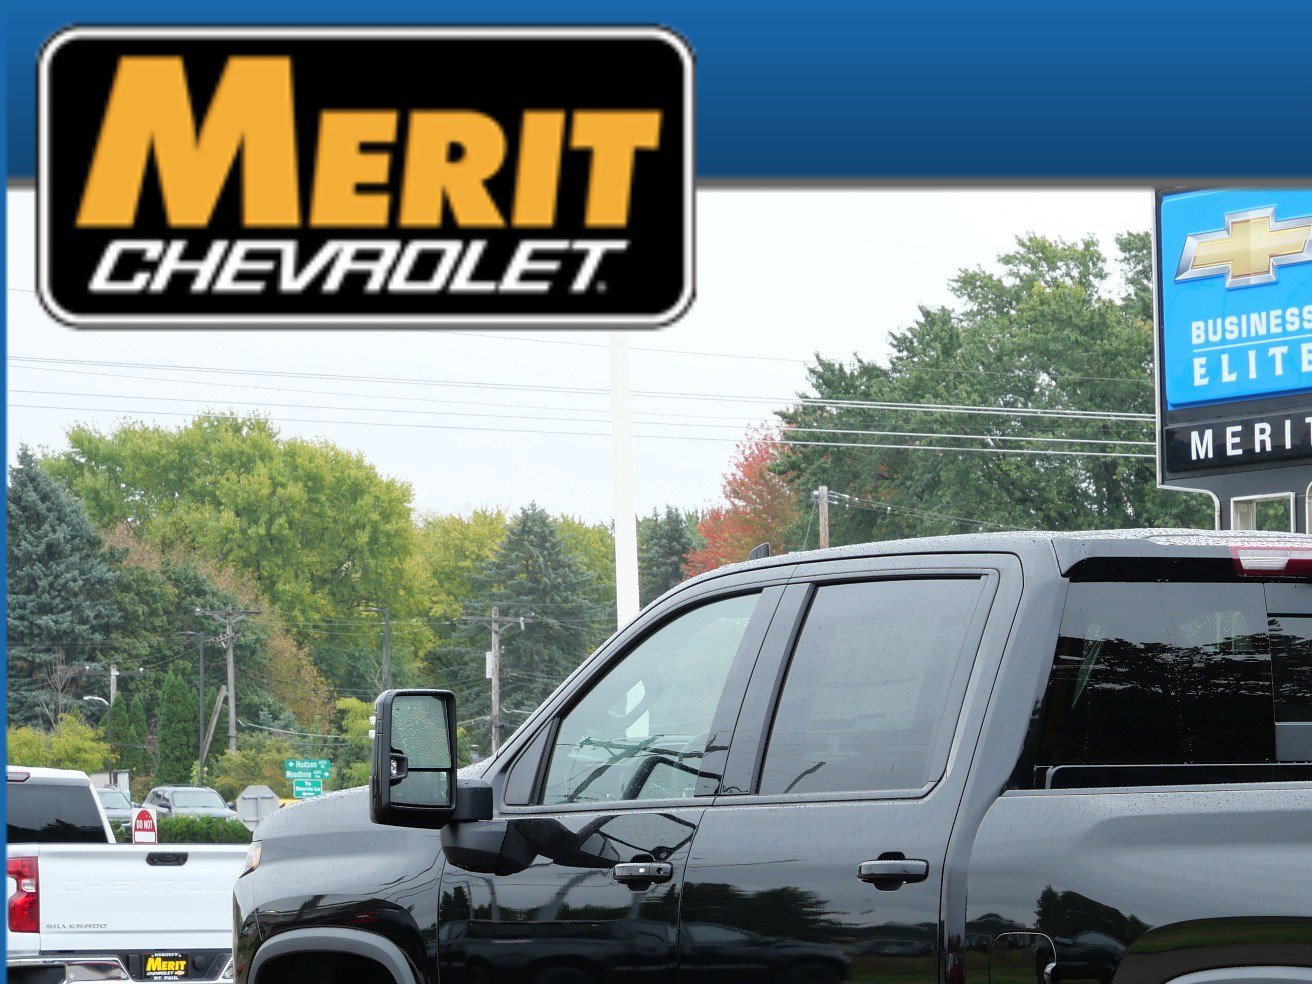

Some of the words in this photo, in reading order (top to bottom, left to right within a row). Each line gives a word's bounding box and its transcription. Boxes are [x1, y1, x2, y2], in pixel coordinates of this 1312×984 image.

[136, 819, 143, 829] DO
[143, 819, 153, 829] NOT
[45, 922, 107, 930] SILVERADO
[145, 957, 187, 972] MERIT
